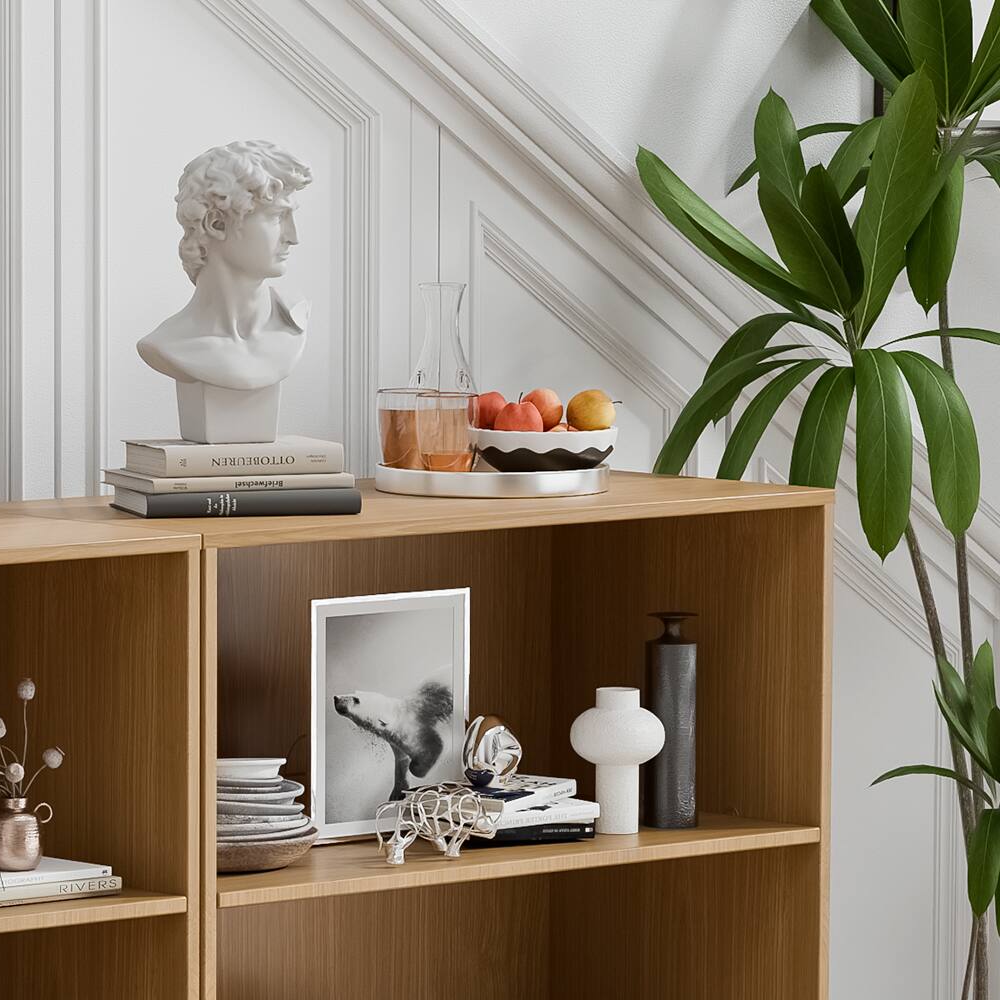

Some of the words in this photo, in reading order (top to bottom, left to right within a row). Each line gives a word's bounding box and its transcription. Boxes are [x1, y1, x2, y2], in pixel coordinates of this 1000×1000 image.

[211, 456, 295, 467] OTTOBEUREN
[235, 479, 283, 488] Briefwechsel
[59, 879, 118, 894] RIVERS
